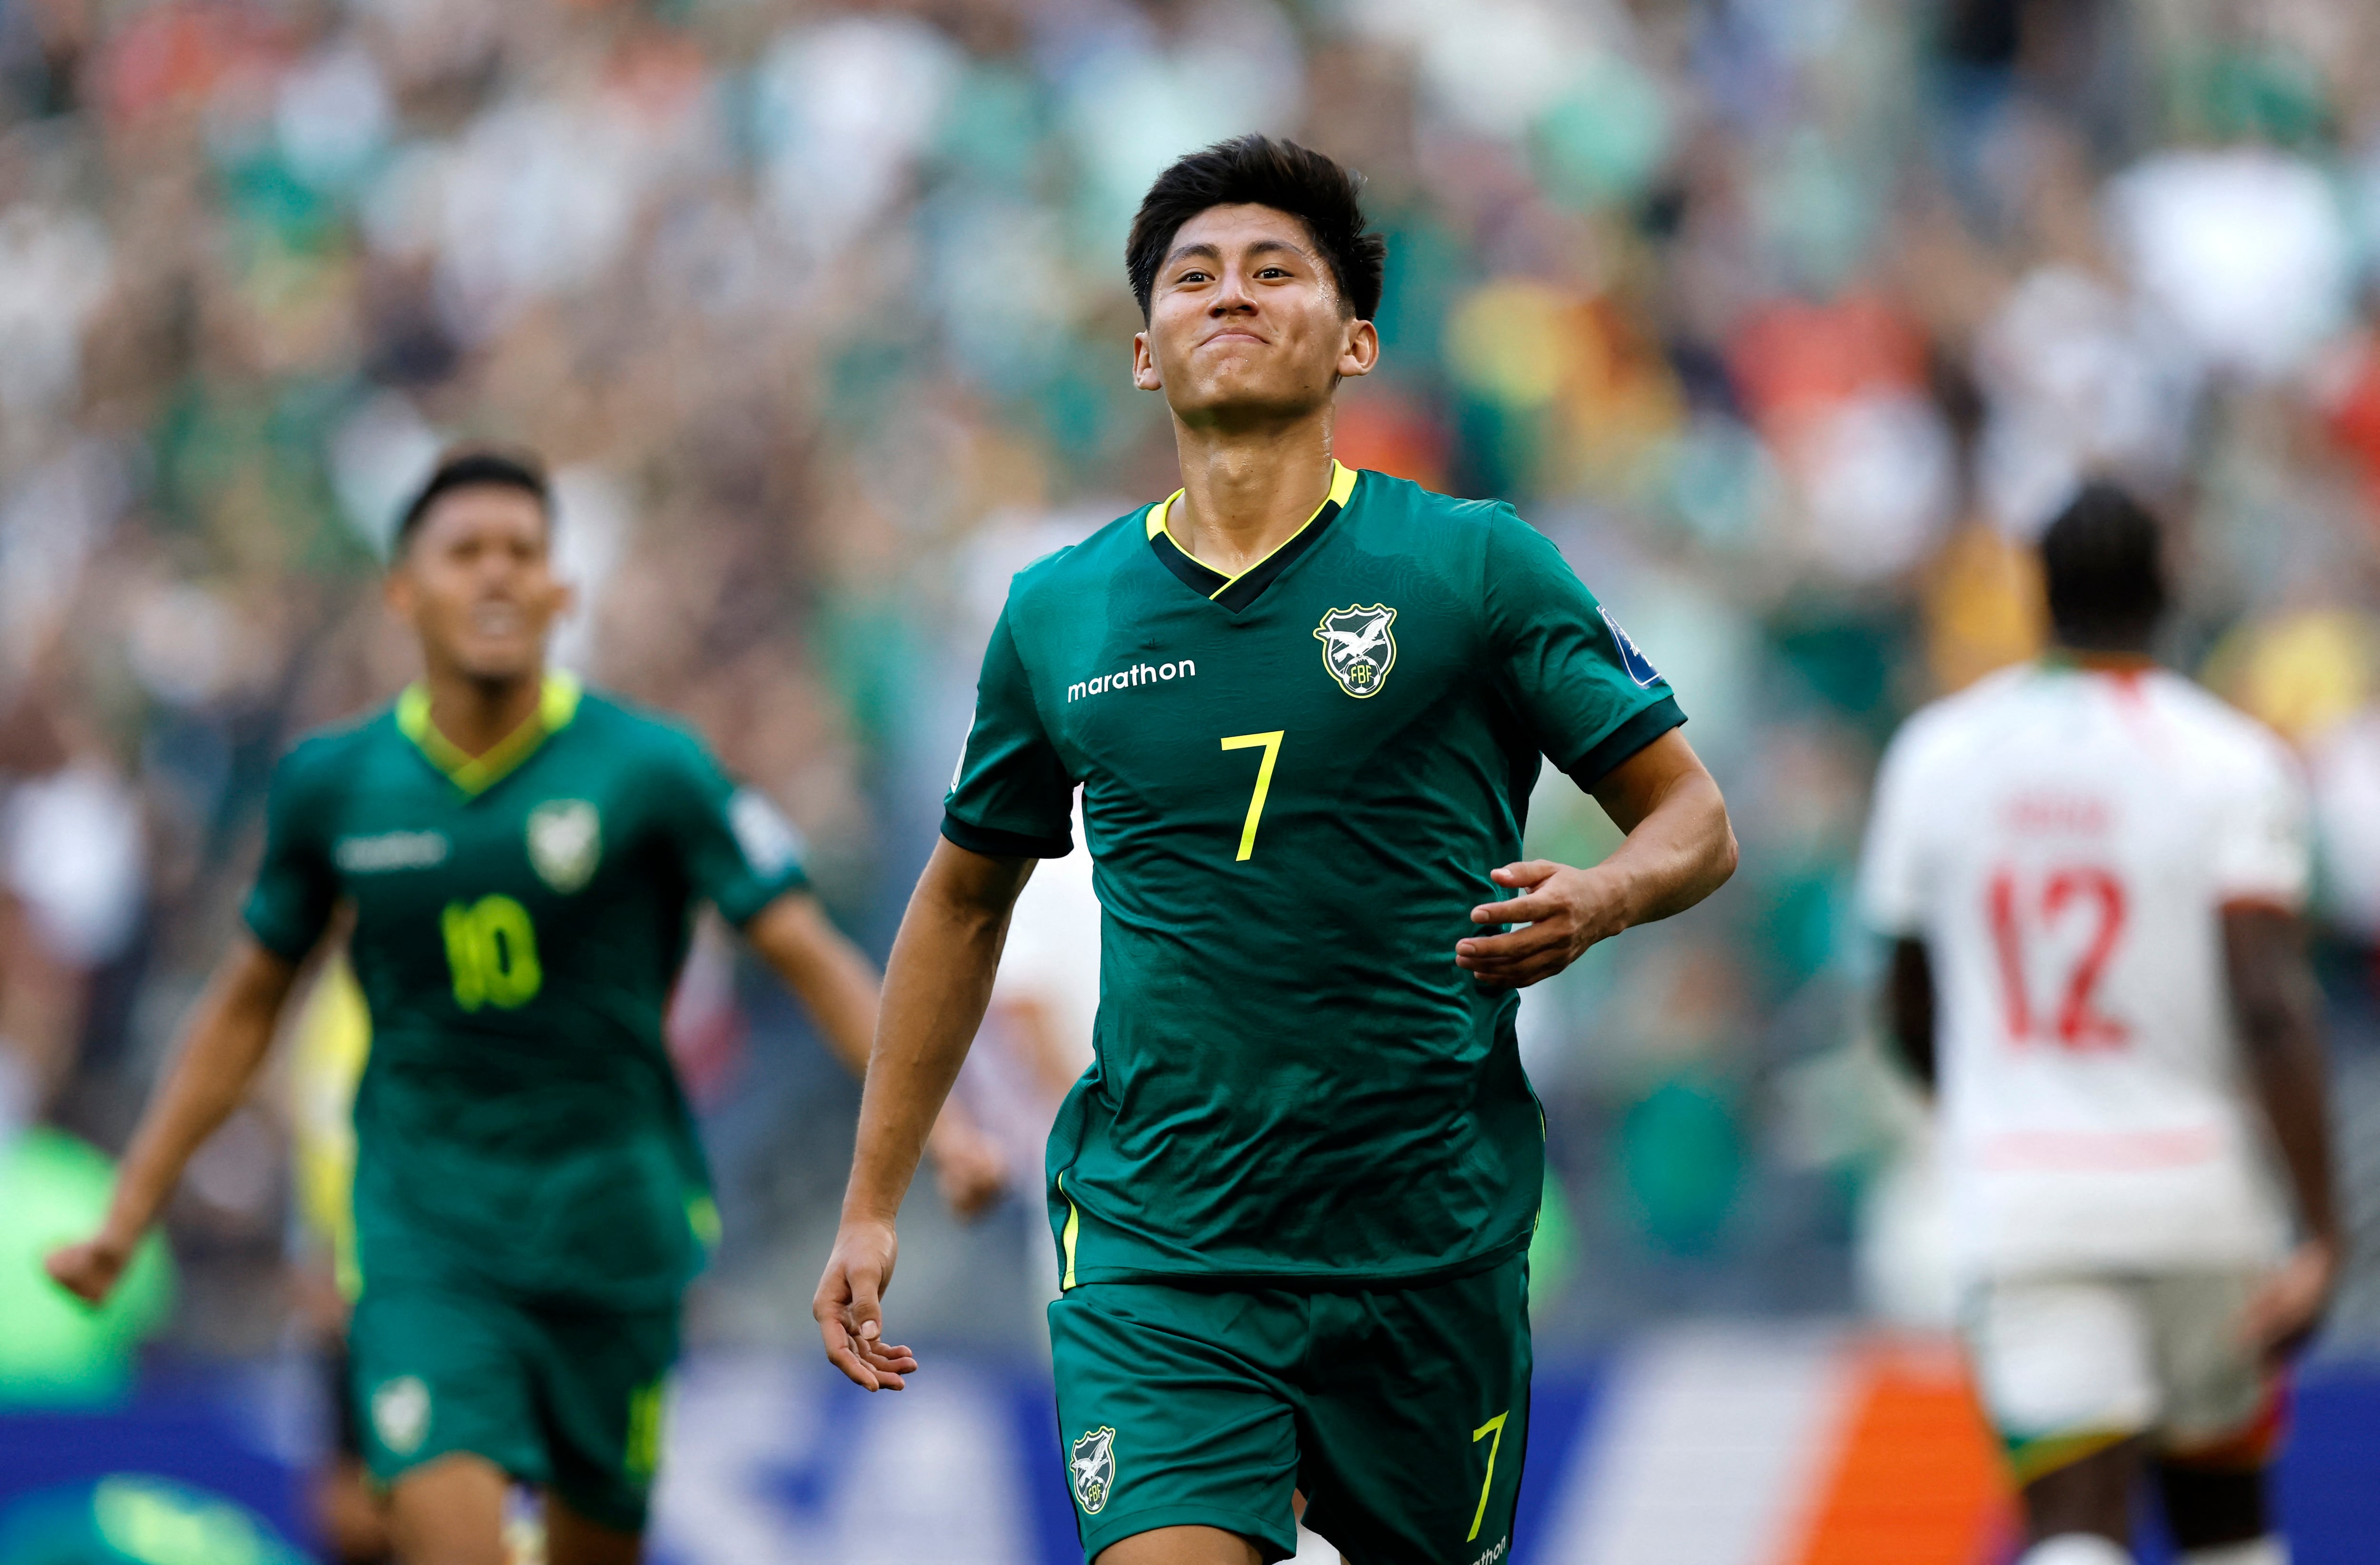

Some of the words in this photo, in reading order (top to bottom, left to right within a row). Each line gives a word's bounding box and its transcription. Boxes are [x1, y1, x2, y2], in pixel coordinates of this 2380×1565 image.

[1068, 659, 1196, 703] marathon
[1350, 665, 1372, 684] FBF
[1220, 730, 1285, 862] 7
[442, 893, 543, 1012] 10
[1985, 864, 2130, 1051] 12
[1088, 1484, 1101, 1502] FBF
[1466, 1410, 1509, 1543] 7
